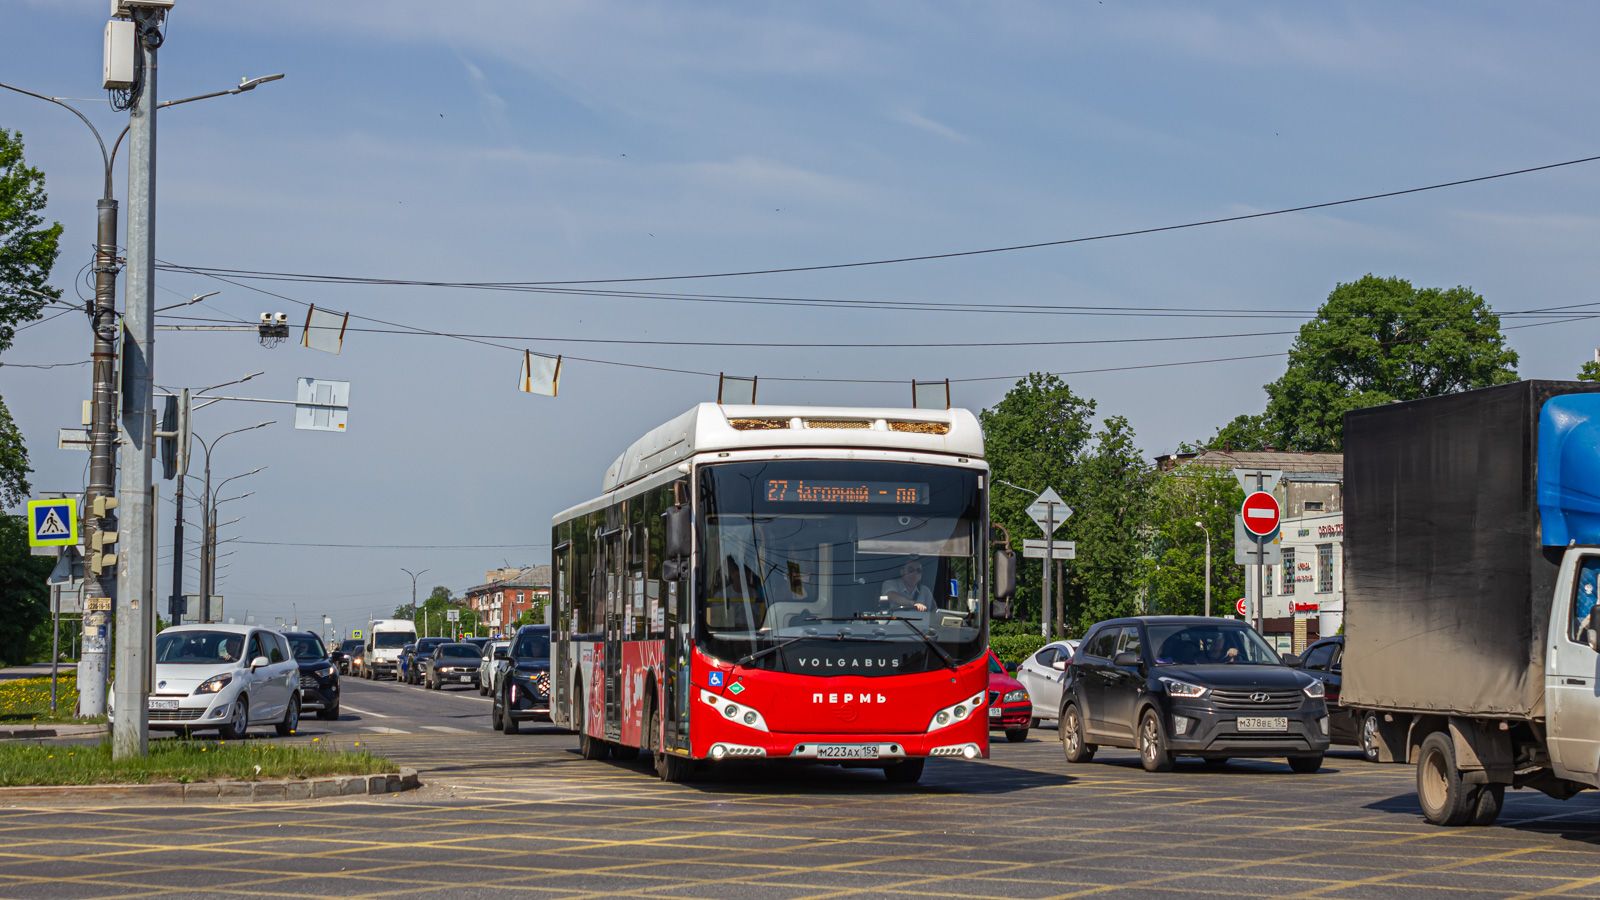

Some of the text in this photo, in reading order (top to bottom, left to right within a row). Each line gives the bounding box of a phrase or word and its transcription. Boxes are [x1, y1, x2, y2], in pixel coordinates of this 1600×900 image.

[768, 480, 788, 501] 27
[798, 658, 900, 667] VOLGABUS
[813, 693, 887, 704] ПЕРМЬ
[820, 746, 877, 757] М223АХ 159
